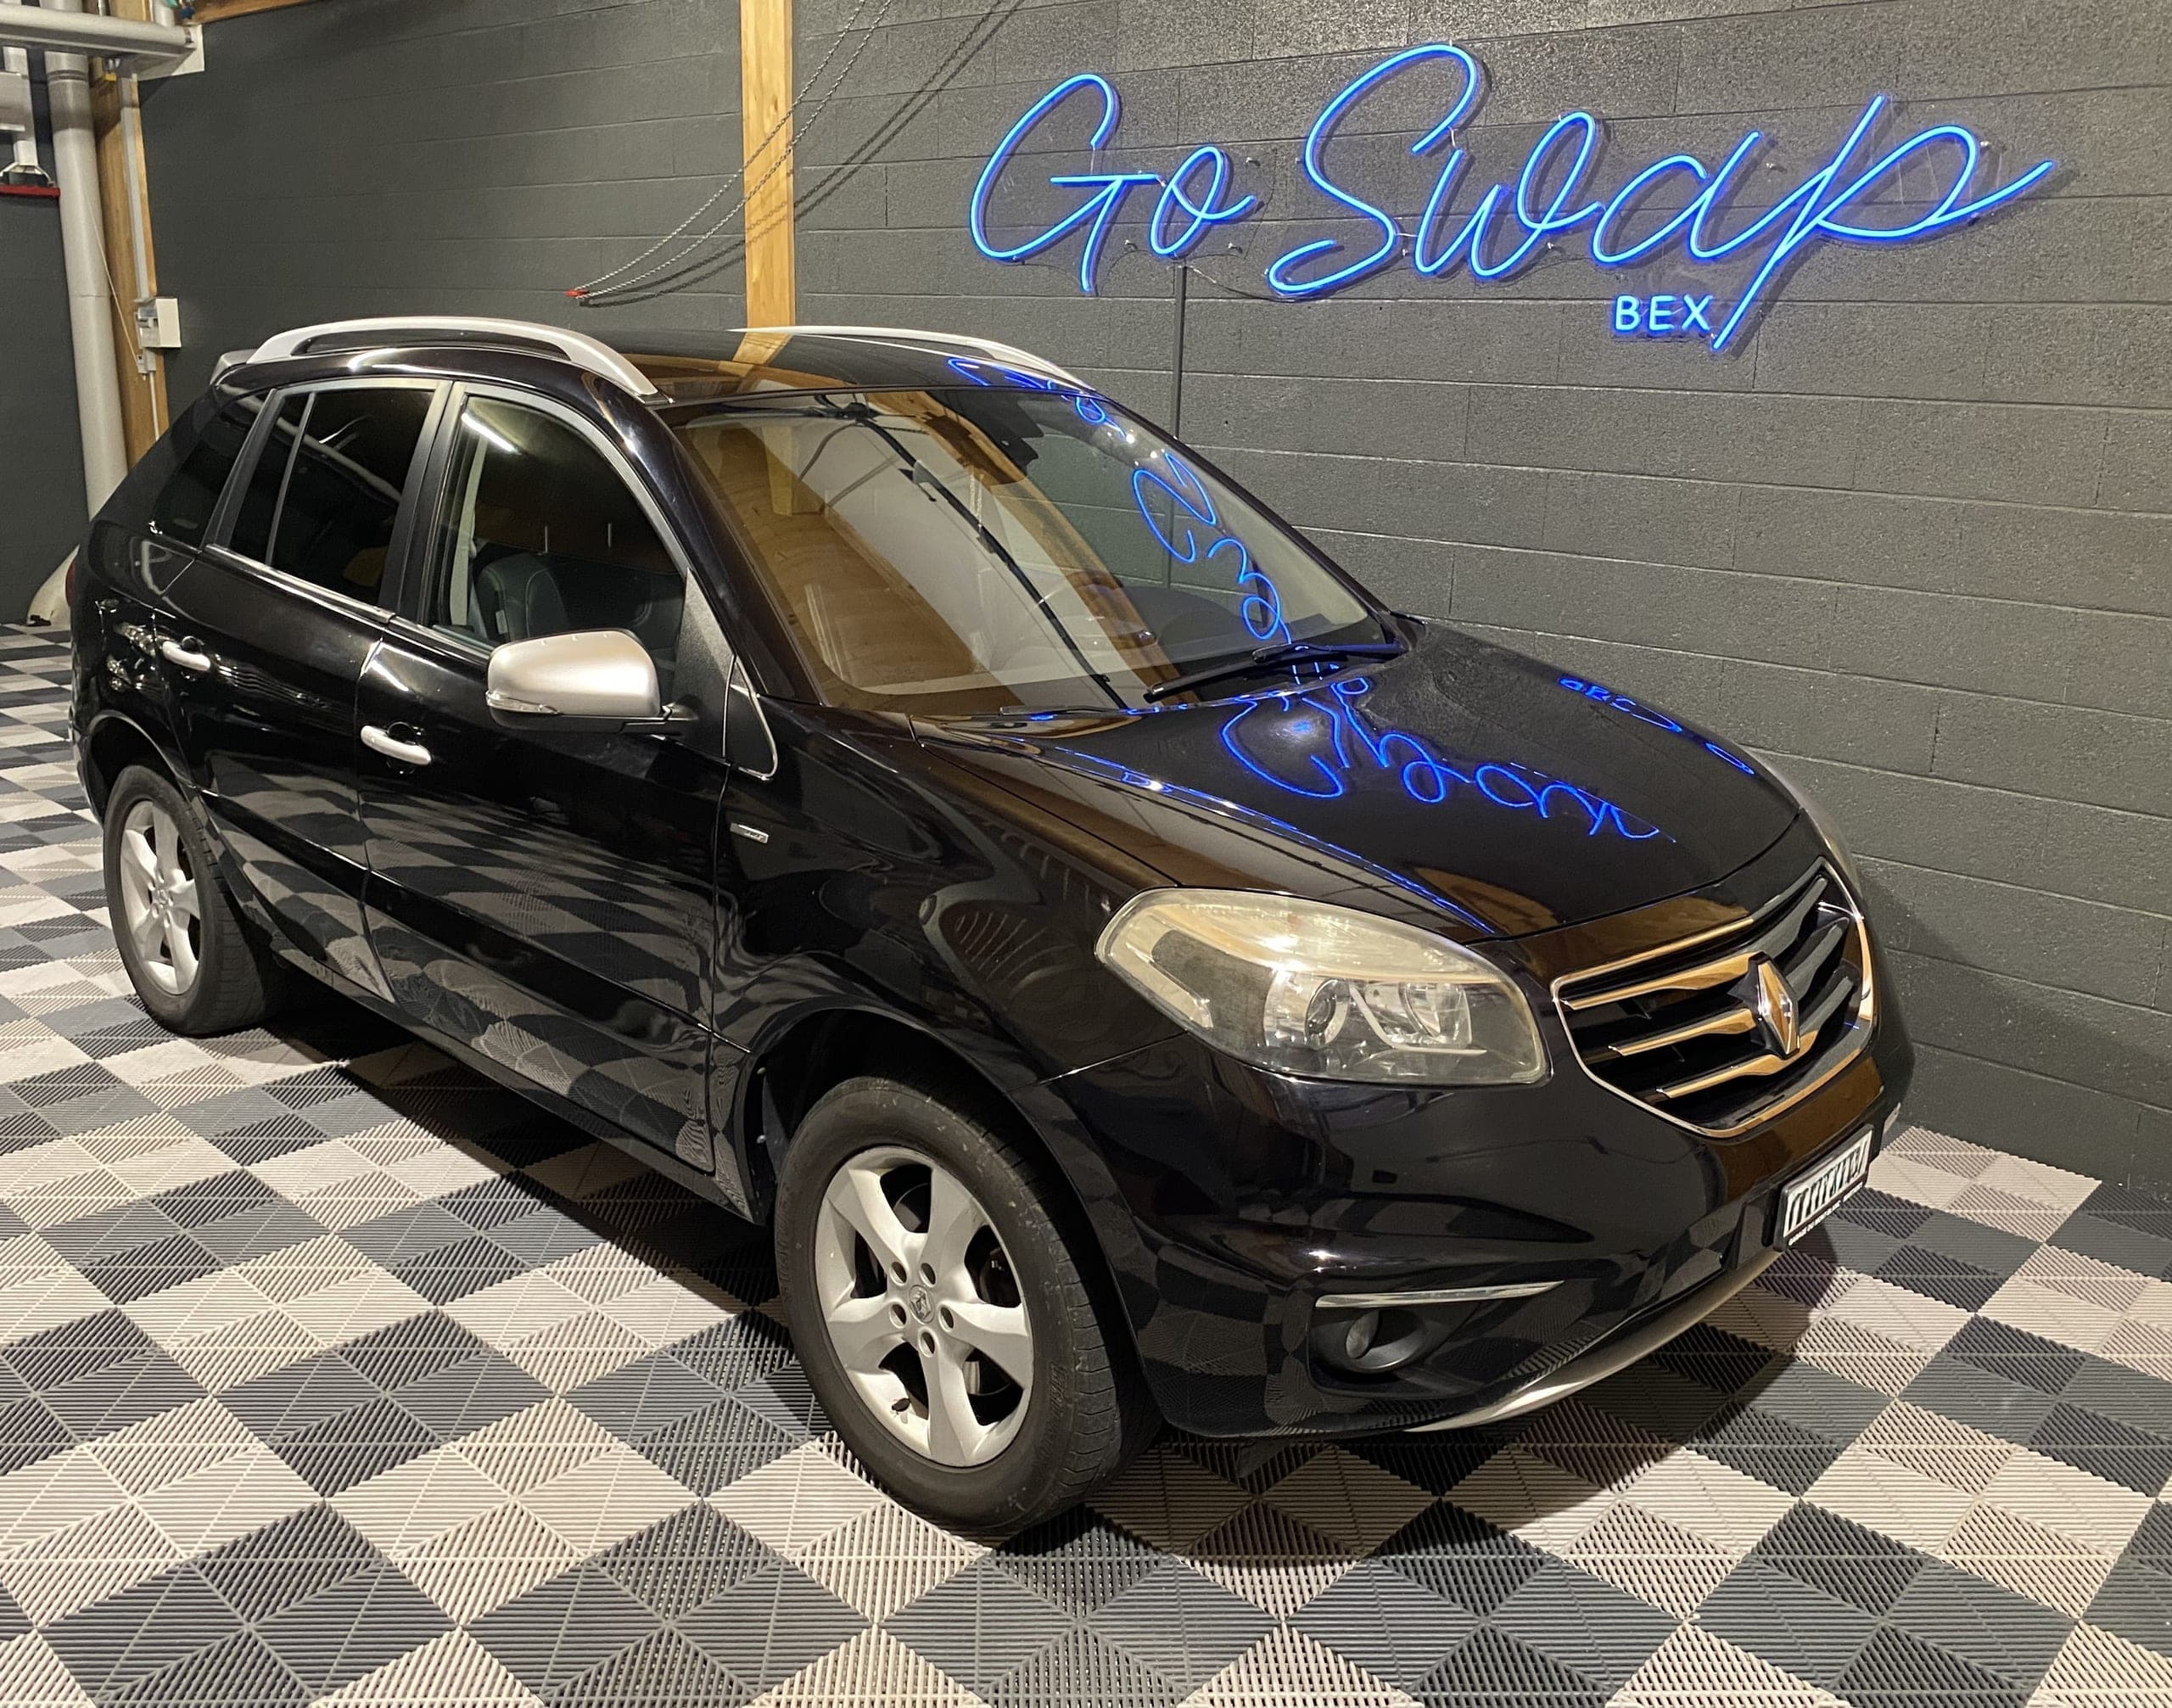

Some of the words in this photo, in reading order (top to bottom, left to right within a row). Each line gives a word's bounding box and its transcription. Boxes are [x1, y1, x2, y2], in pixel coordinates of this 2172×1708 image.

[971, 74, 1256, 292] Go
[1268, 44, 2055, 351] Swap
[1615, 294, 1714, 332] BEX
